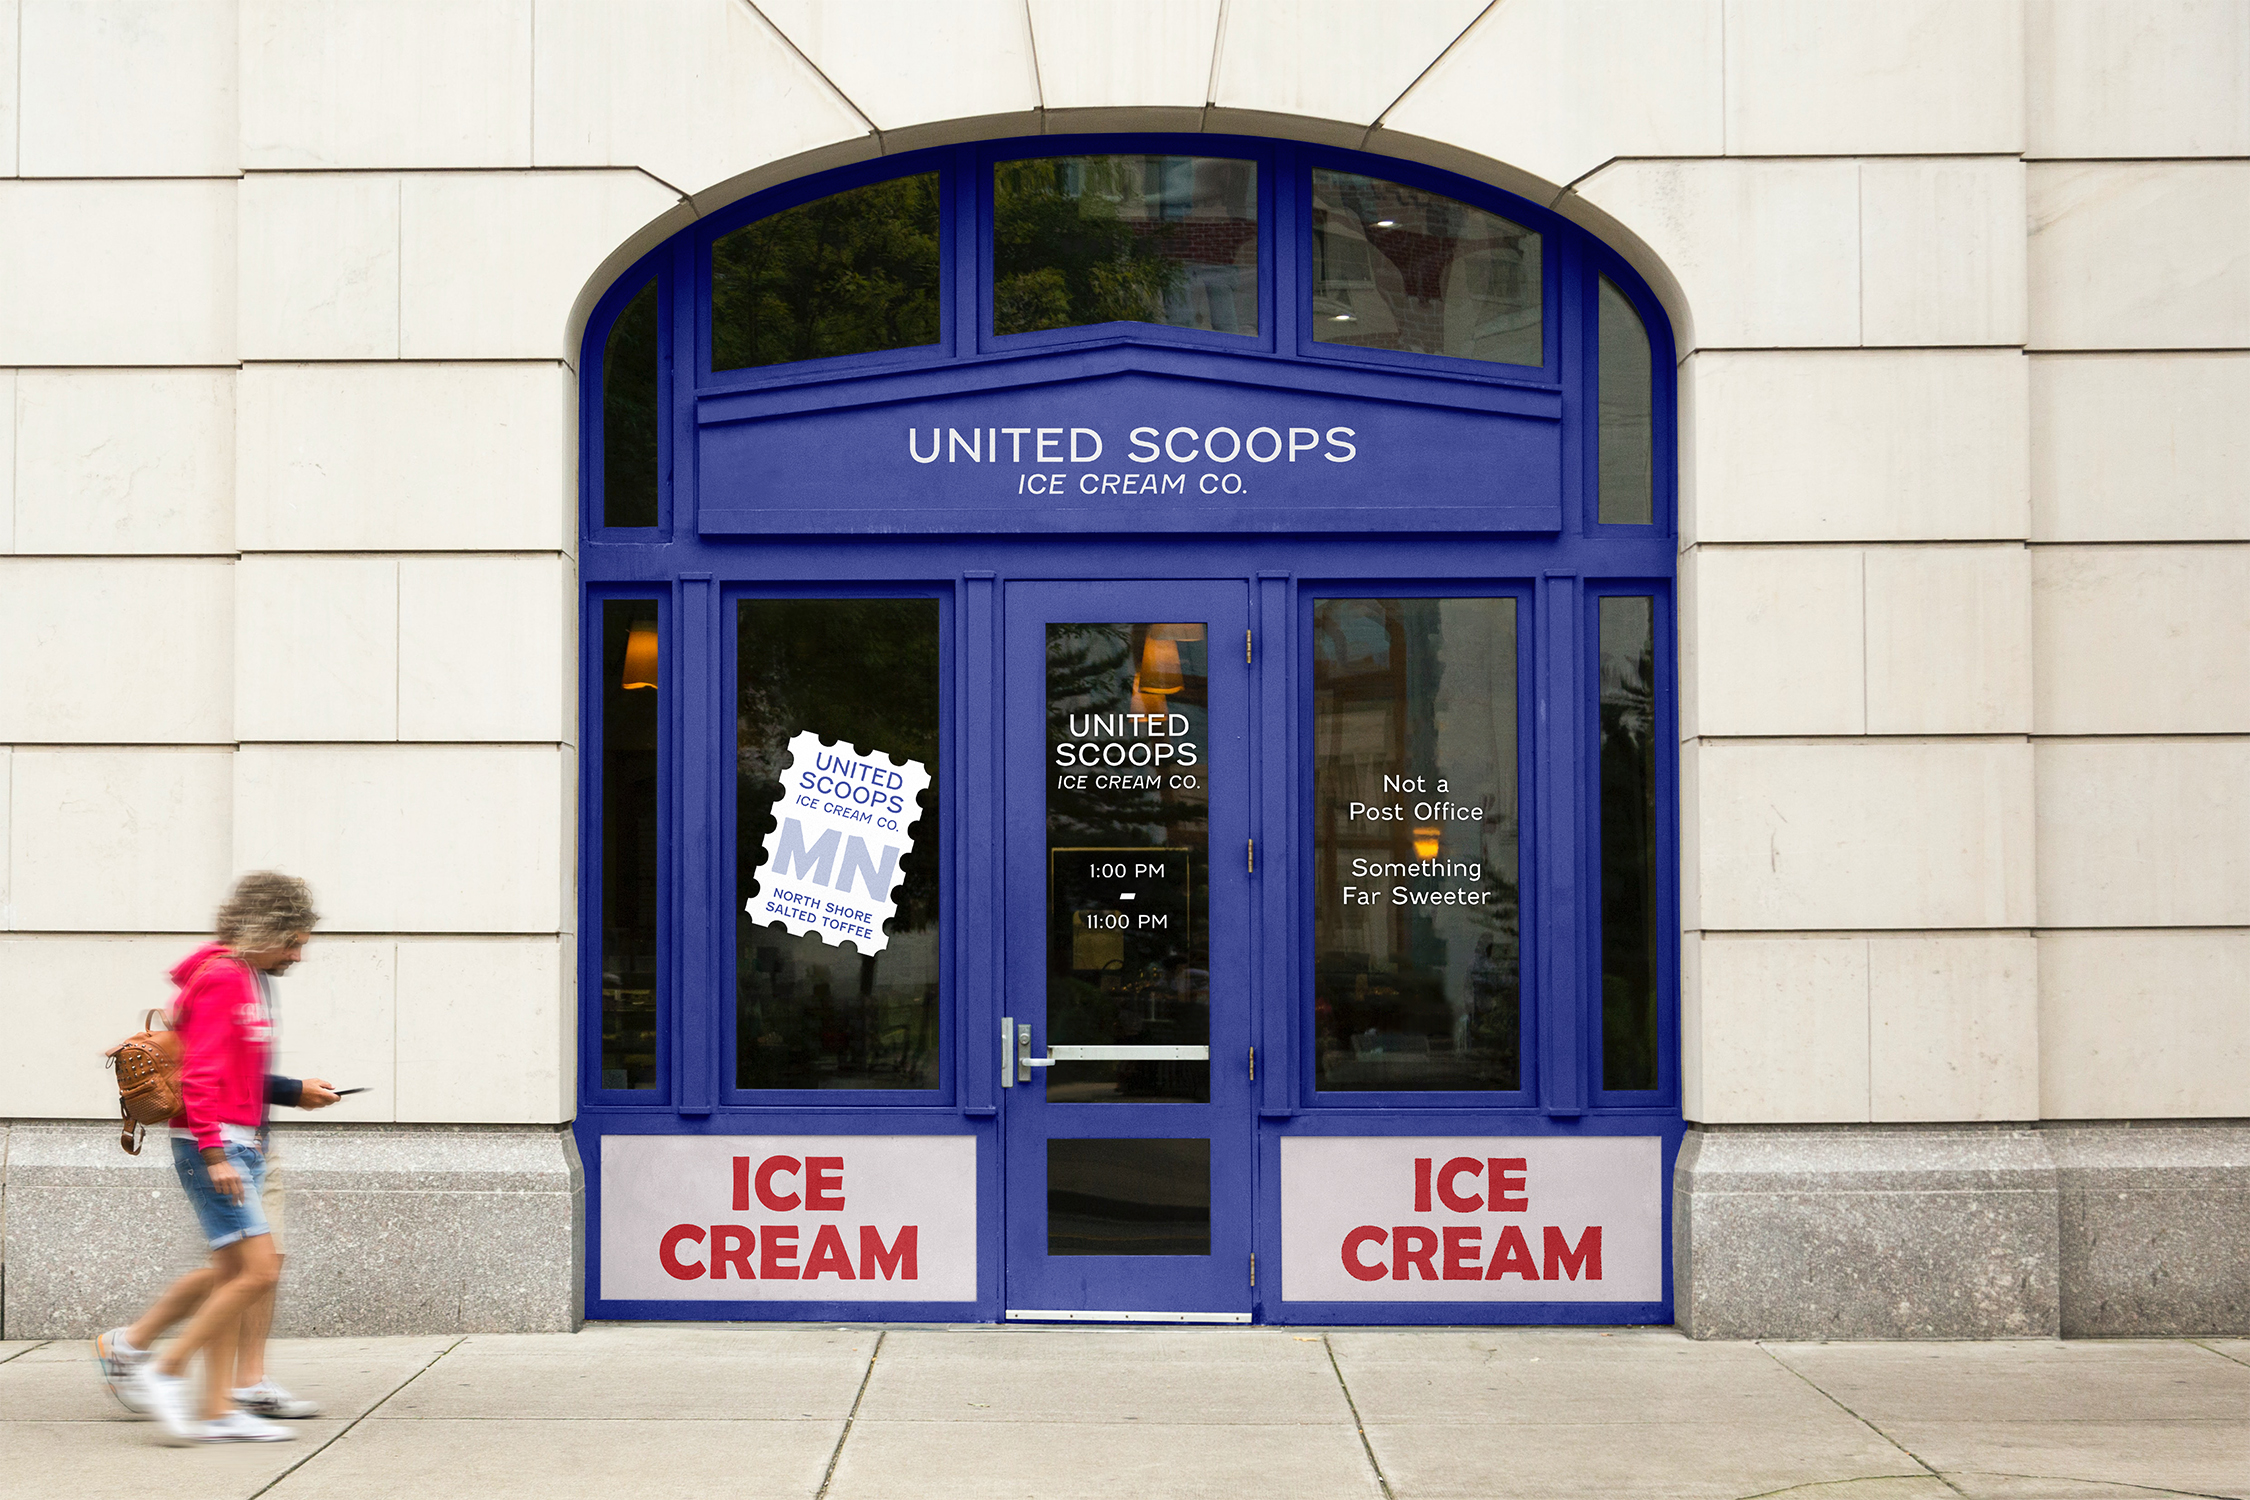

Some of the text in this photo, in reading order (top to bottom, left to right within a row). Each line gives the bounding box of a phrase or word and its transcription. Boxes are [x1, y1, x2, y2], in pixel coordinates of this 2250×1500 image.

[909, 426, 1357, 464] UNITED SCOOPS
[1018, 473, 1248, 495] ICE CREAM CO.
[1069, 713, 1190, 738] UNITED
[815, 751, 904, 790] UNITED
[1055, 742, 1198, 767] SCOOPS
[798, 770, 905, 814] SCOOPS
[1057, 774, 1201, 790] ICE CREAM CO.
[1383, 774, 1450, 794] Not a
[795, 793, 900, 833] ICE CREAM CO.
[1349, 801, 1484, 822] Post Office
[771, 816, 900, 903] MN
[1089, 862, 1166, 879] 1:00 PM
[1351, 857, 1482, 882] Something
[773, 887, 873, 924] NORTH SHORE
[1342, 886, 1492, 906] Far Sweeter
[765, 901, 874, 940] SALTED TOFFEE
[1086, 913, 1168, 930] 11:00 PM
[731, 1154, 846, 1212] ICE
[1414, 1156, 1529, 1214] ICE
[659, 1223, 919, 1281] CREAM
[1341, 1225, 1603, 1282] CREAM
